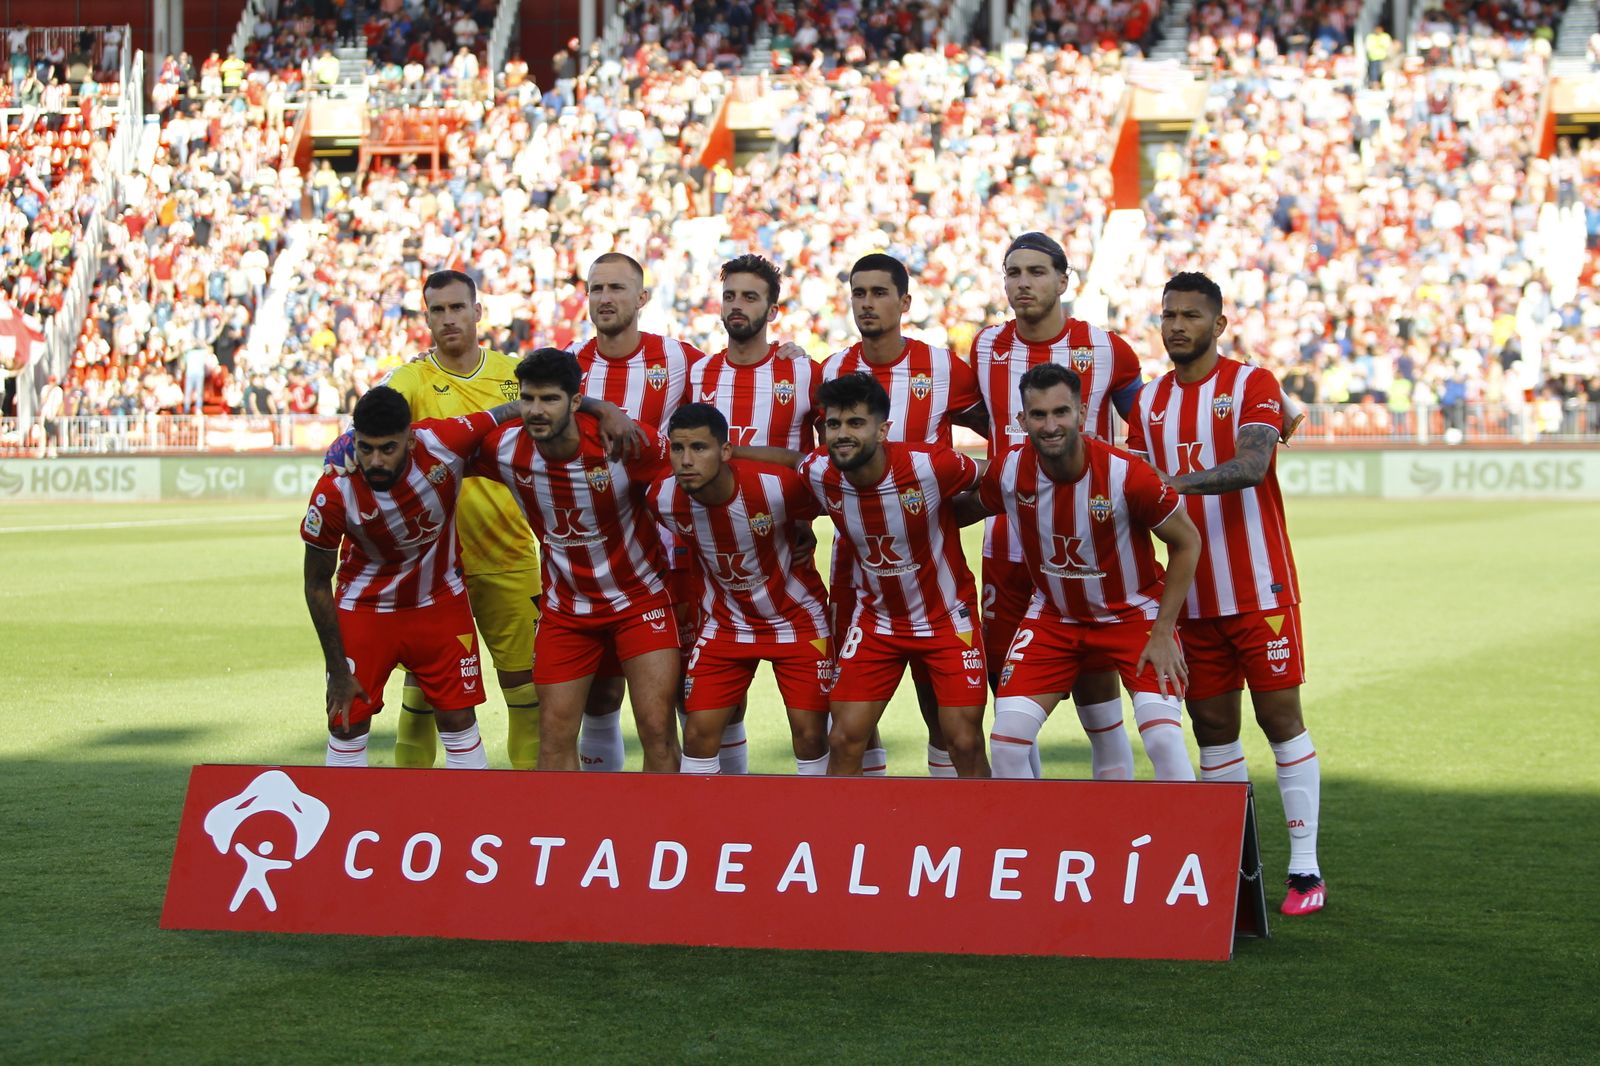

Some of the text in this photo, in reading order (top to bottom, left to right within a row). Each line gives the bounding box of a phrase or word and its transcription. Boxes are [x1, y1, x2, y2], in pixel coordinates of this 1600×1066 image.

[31, 465, 135, 493] HOASIS
[206, 466, 245, 488] TCI
[273, 465, 323, 493] GR
[1452, 459, 1584, 490] HOASIS
[551, 508, 591, 534] JK
[863, 536, 904, 565] JK
[1048, 535, 1089, 566] JK
[715, 553, 754, 580] JK
[642, 608, 666, 622] KUDU
[963, 658, 983, 669] KUDU
[1267, 648, 1290, 661] KUDU
[461, 665, 479, 677] KUDU
[817, 668, 833, 679] KUD
